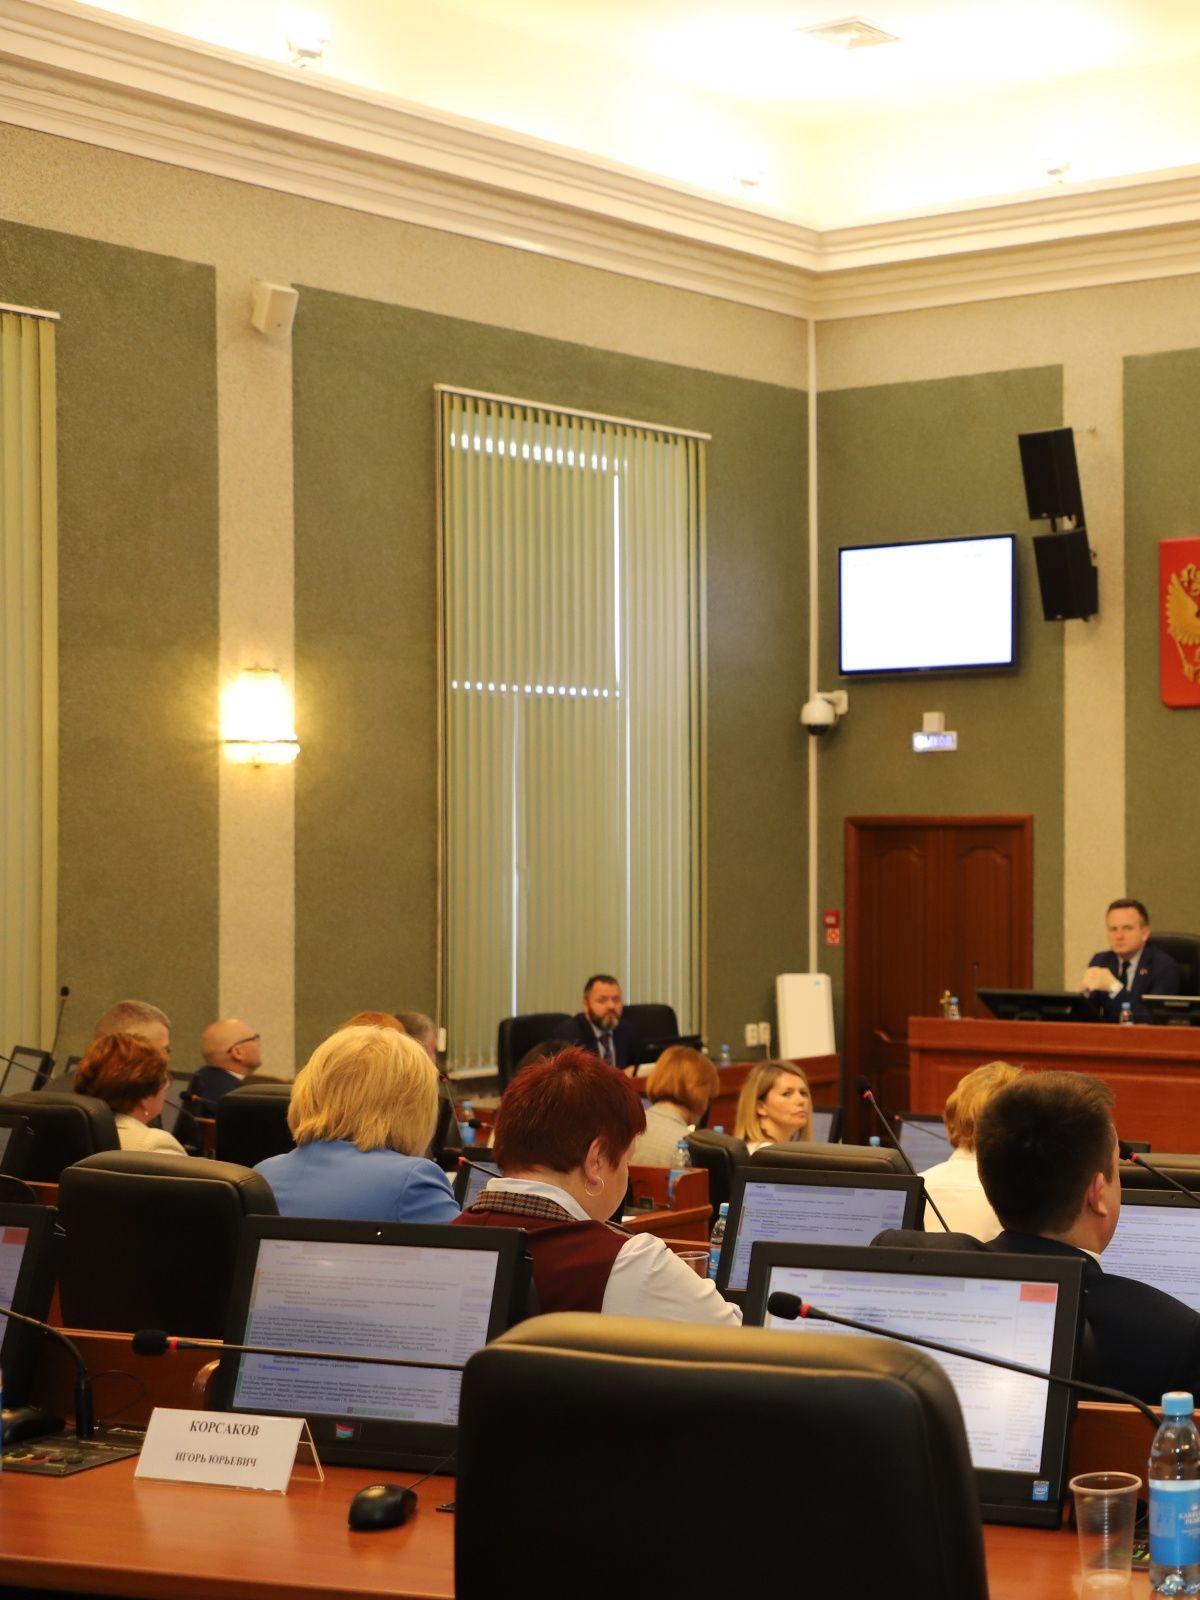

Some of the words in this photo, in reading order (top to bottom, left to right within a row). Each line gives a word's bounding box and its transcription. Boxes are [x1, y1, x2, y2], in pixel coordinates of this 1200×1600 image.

[190, 1420, 260, 1437] КОРСАКОВ
[175, 1451, 207, 1463] ИГОРЬ
[208, 1455, 257, 1467] ЮРЬЕВИЧ
